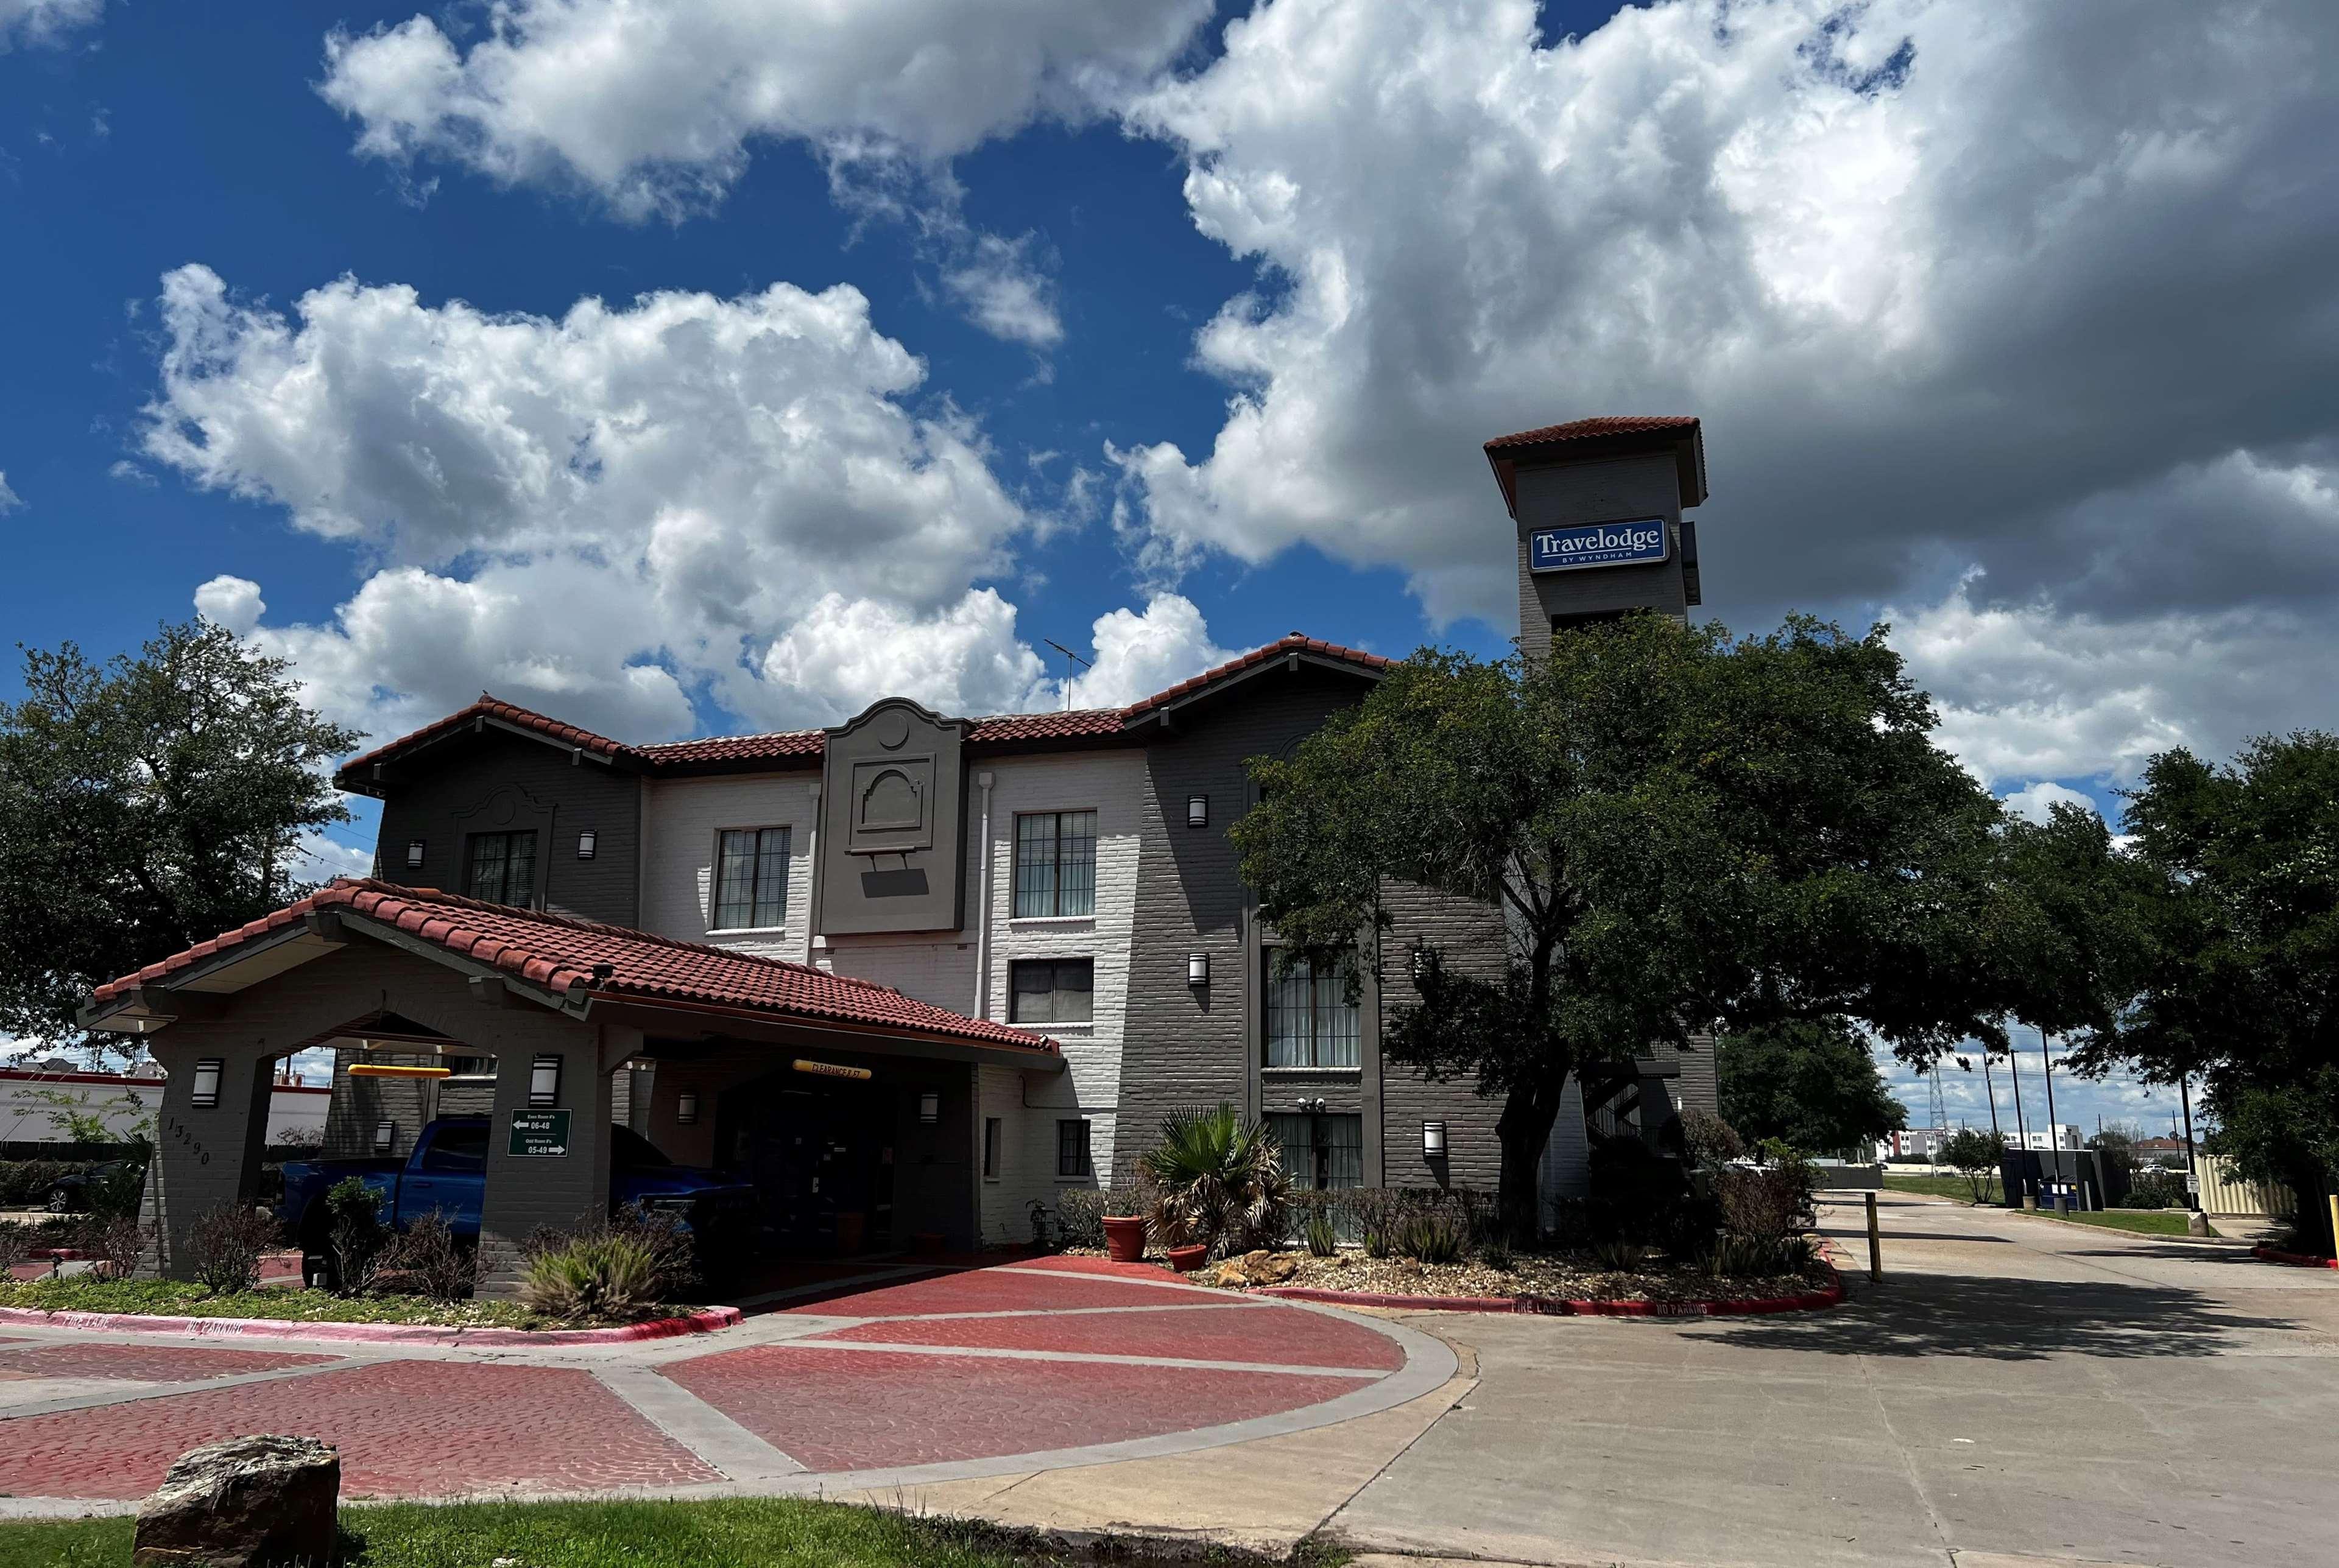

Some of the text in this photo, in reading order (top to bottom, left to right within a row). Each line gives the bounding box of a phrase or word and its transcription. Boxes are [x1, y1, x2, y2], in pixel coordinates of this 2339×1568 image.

[1536, 529, 1659, 554] Travelodge
[1579, 552, 1632, 561] WYNDHAM
[811, 1063, 847, 1077] CLEARANCE
[168, 1117, 210, 1165] 13290
[1511, 1299, 1562, 1314] FIRE LANE
[1656, 1303, 1707, 1315] NO PARKING
[62, 1314, 110, 1329] FIRE LANE
[203, 1321, 244, 1335] PARKING
